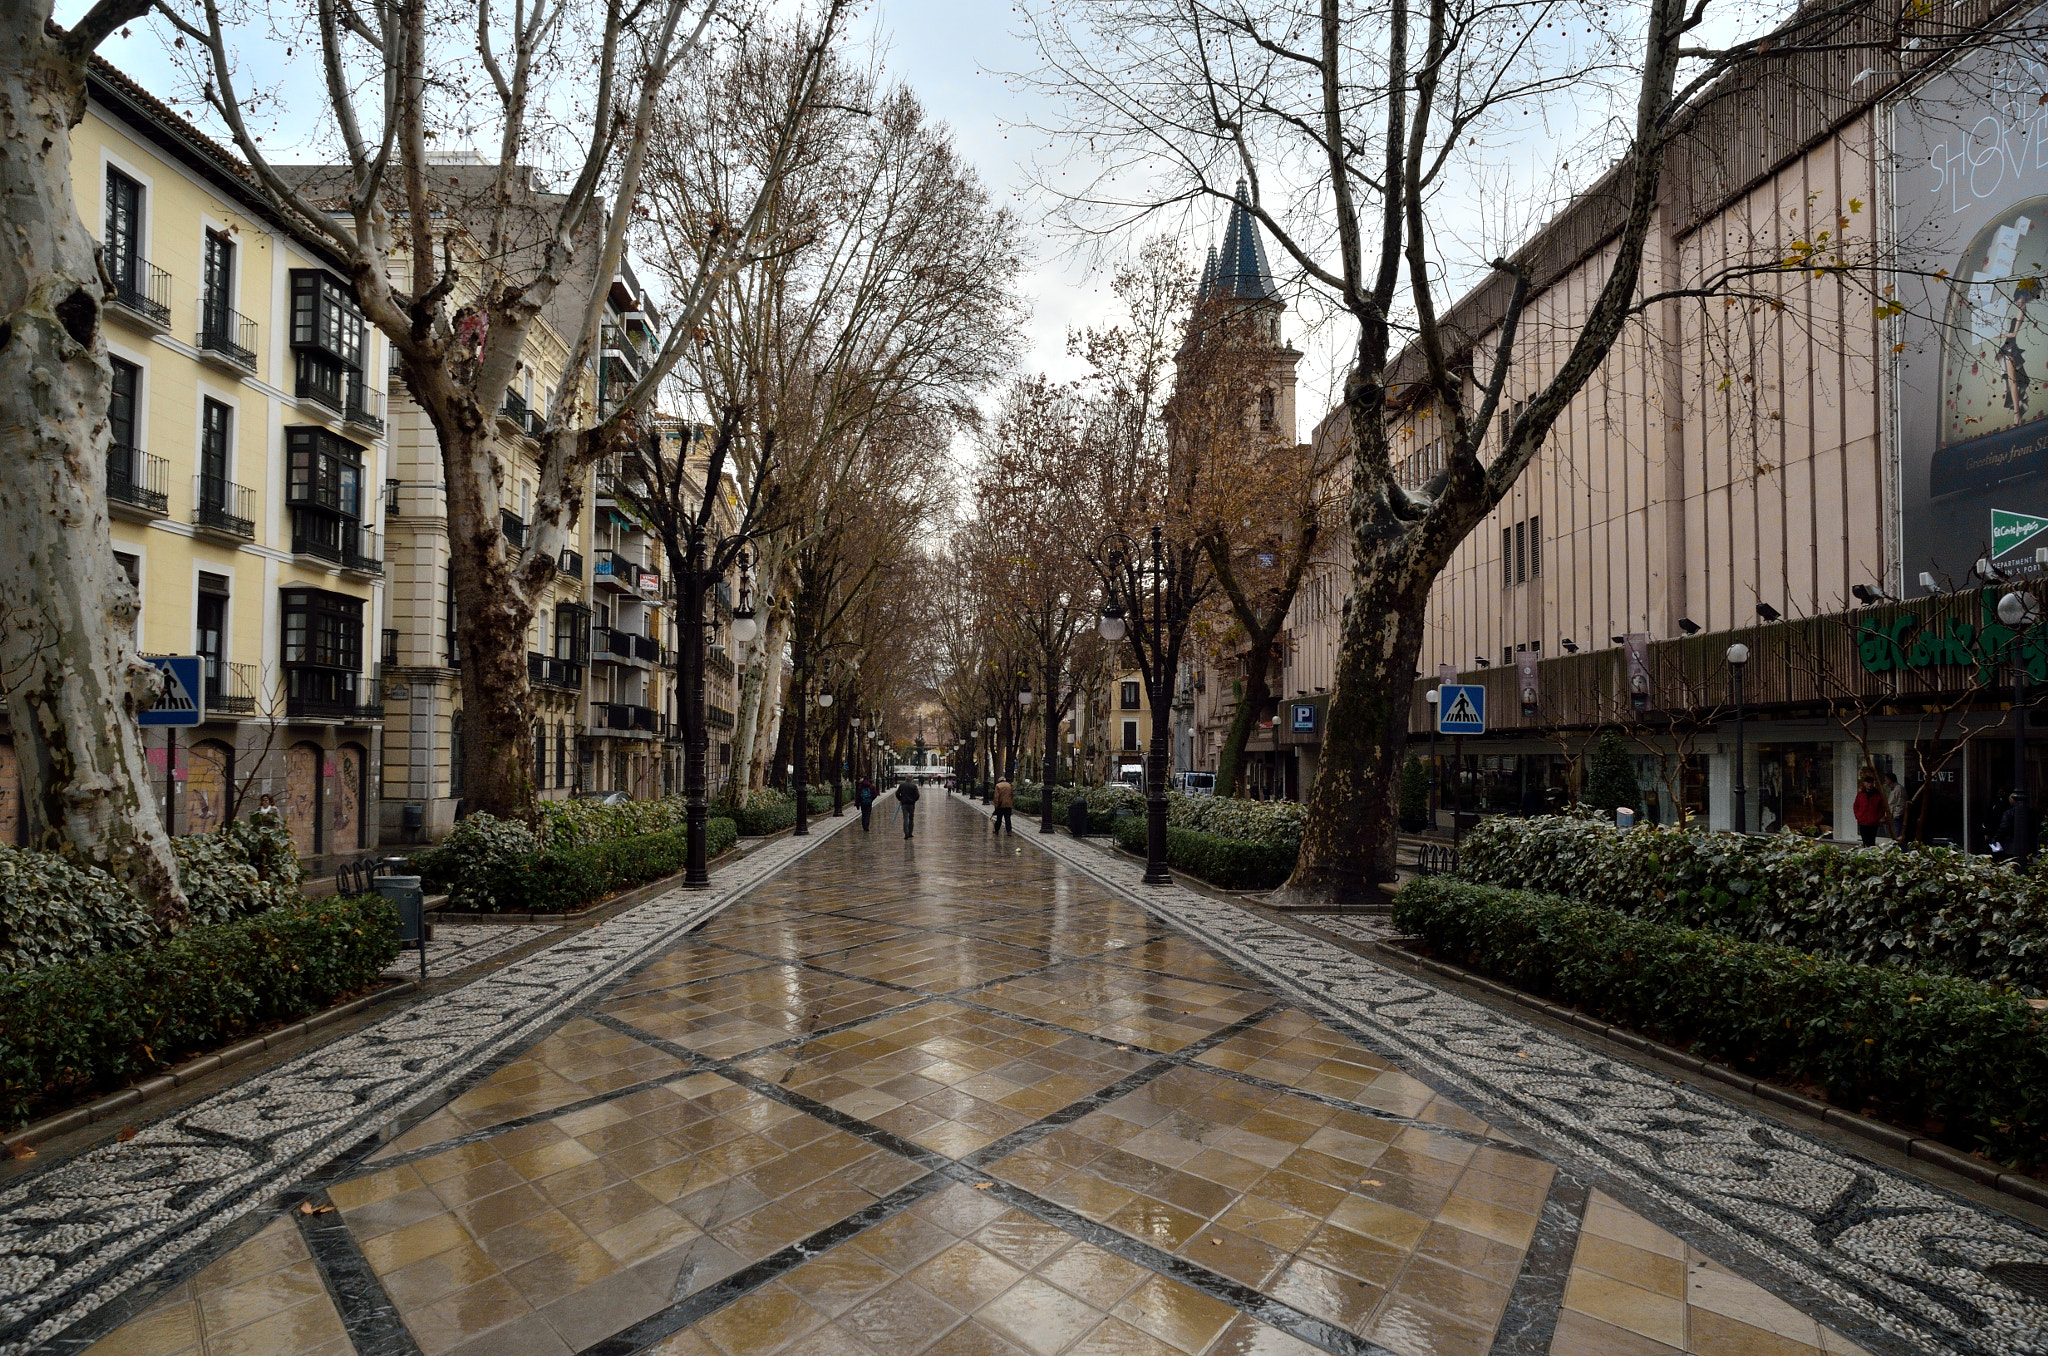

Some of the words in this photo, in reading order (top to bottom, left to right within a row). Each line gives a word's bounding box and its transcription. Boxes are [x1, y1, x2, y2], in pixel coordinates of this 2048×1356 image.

[1966, 451, 2008, 471] Greetings
[2008, 444, 2033, 463] from
[1297, 707, 1310, 722] P
